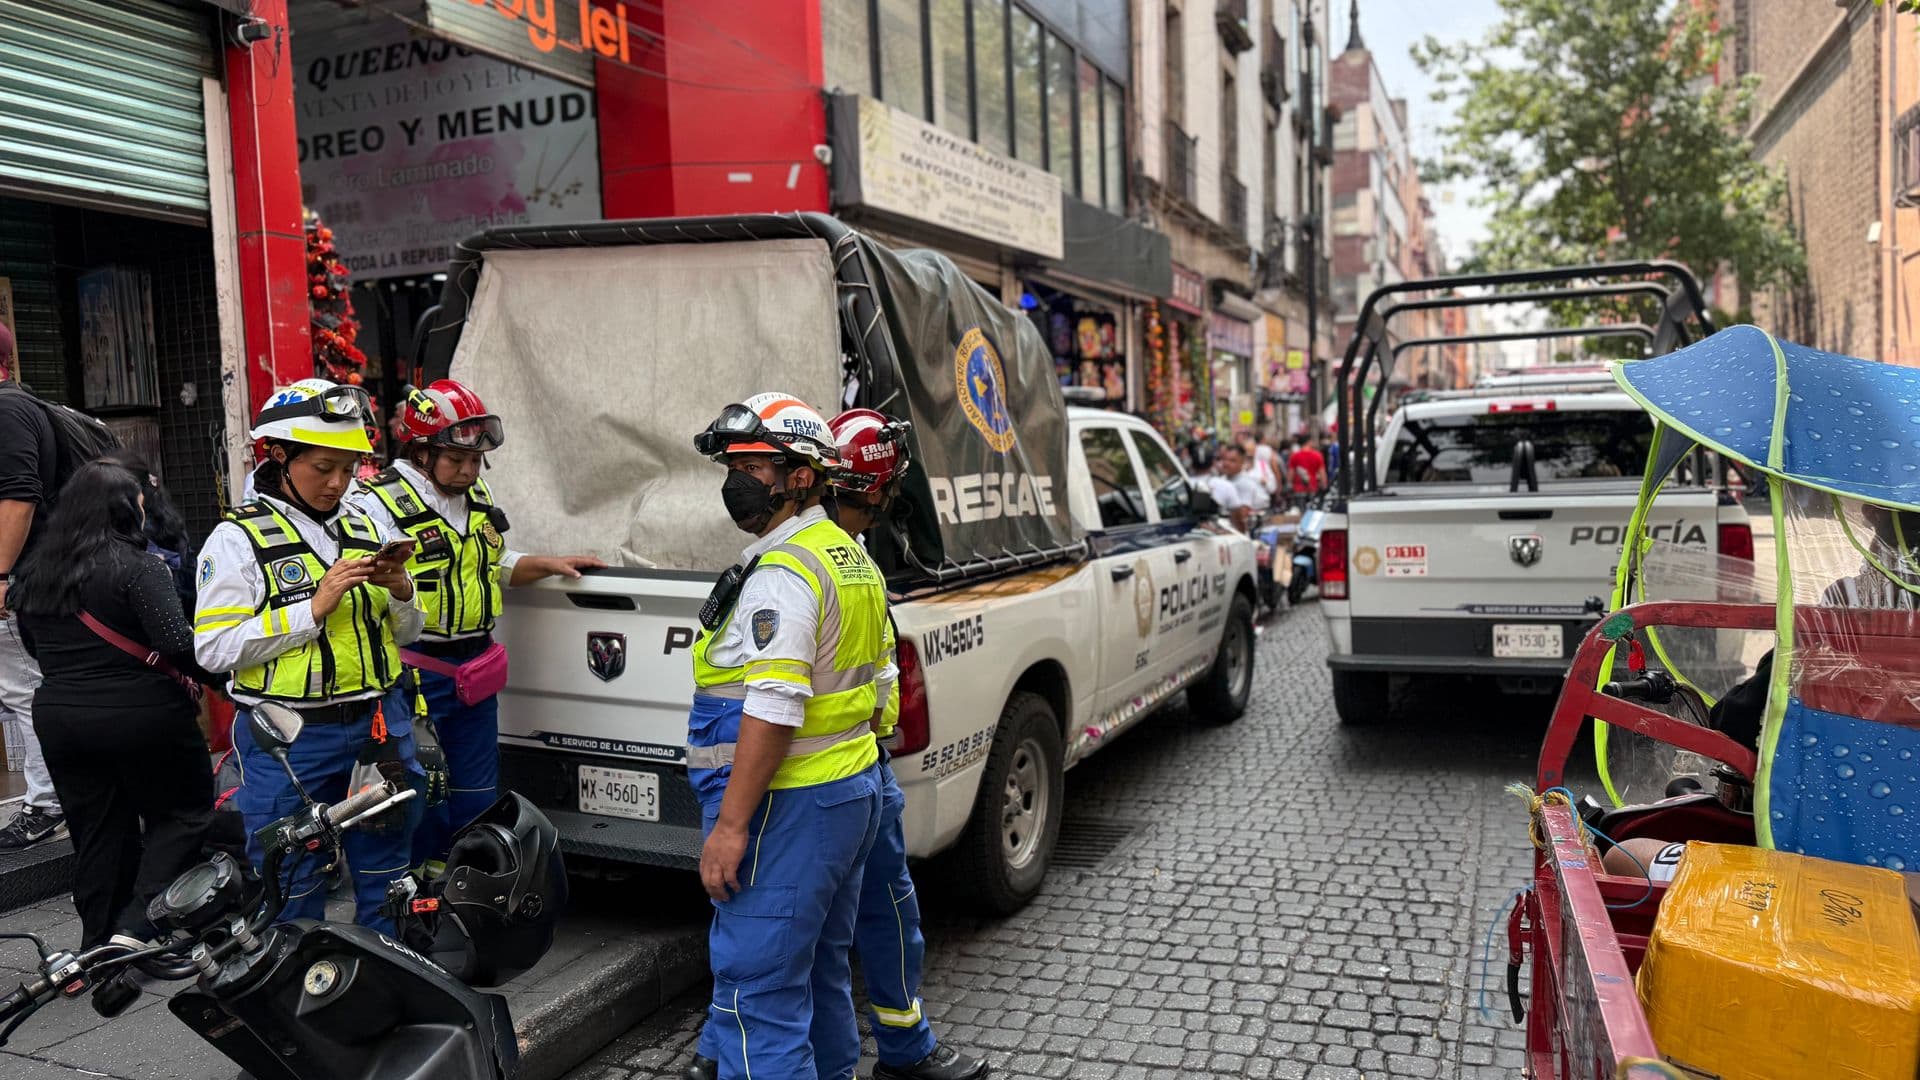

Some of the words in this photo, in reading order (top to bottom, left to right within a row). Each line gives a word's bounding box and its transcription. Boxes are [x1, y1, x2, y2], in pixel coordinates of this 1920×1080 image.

[400, 117, 422, 146] Y
[783, 418, 823, 433] ERUM
[861, 440, 895, 455] ERUM
[826, 545, 870, 567] ERUM
[549, 735, 560, 745] AL
[562, 737, 598, 749] SERVICIO
[600, 741, 611, 750] DE
[613, 743, 624, 752] LA
[626, 745, 675, 757] COMUNIDAD
[921, 750, 938, 772] 55
[940, 743, 954, 764] 52
[957, 736, 969, 756] 08
